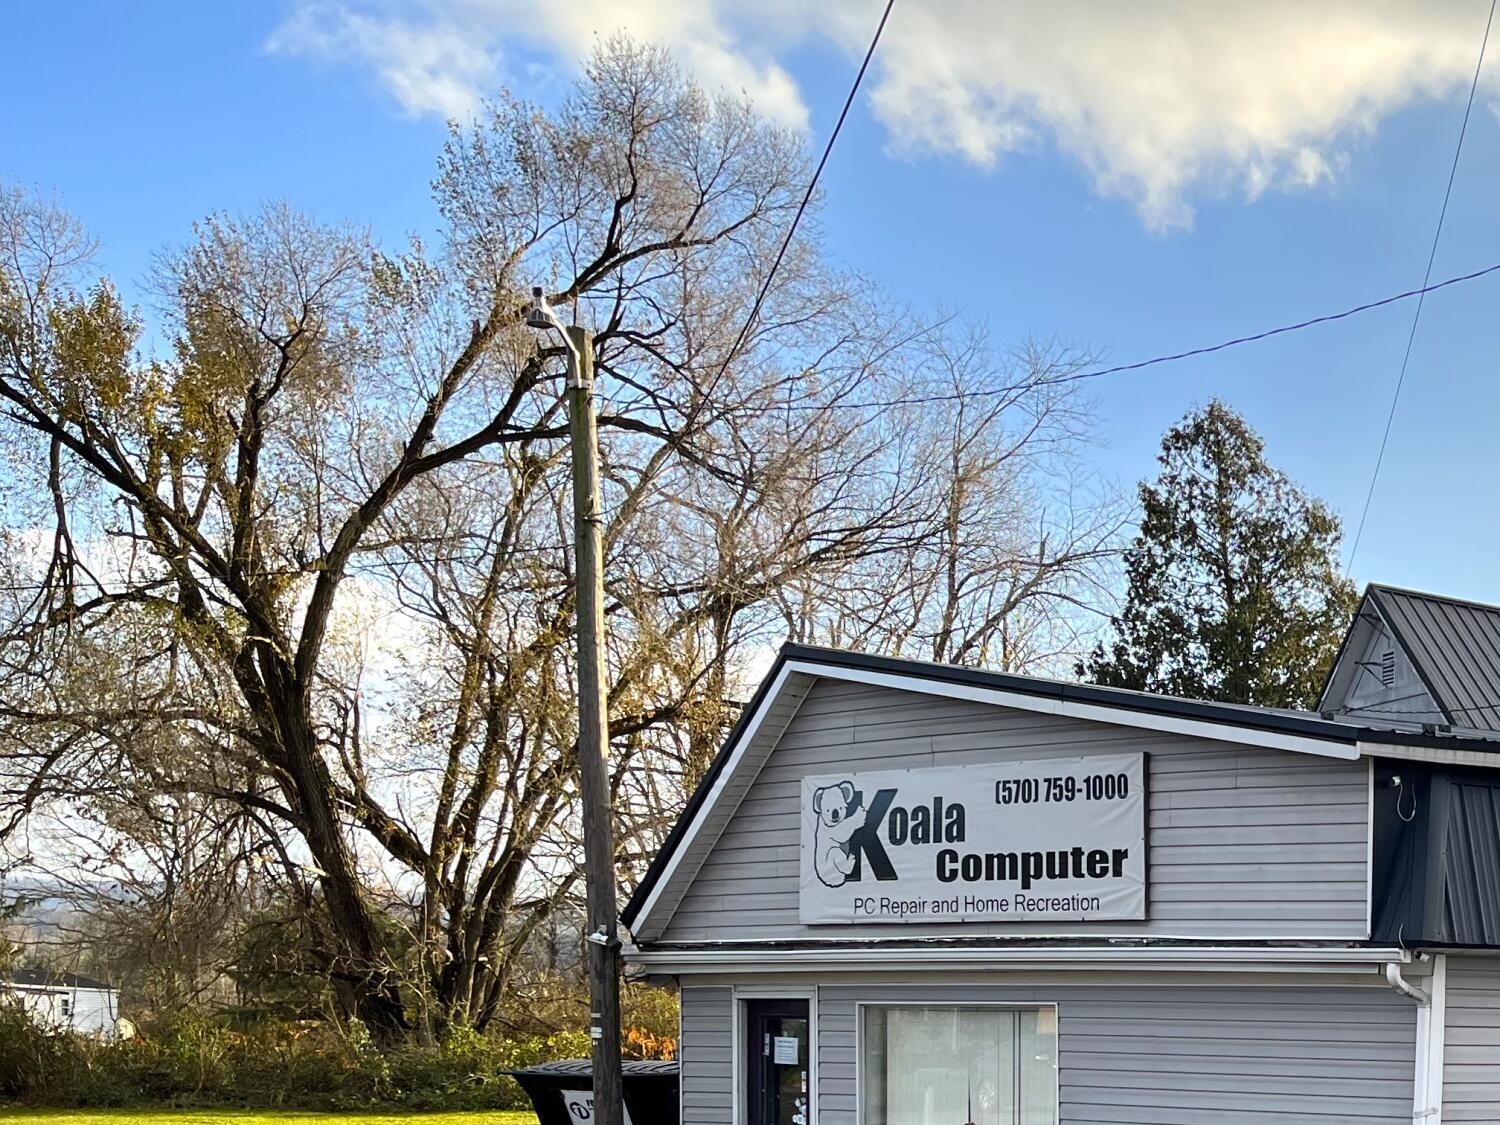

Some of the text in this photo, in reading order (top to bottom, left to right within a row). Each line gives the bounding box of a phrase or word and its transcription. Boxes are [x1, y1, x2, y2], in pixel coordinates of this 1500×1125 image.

[995, 773, 1129, 805] (570) 759-1000
[846, 788, 966, 882] Koala
[936, 846, 1129, 890] Computer
[854, 893, 1100, 918] PC Repair and Home Recreation
